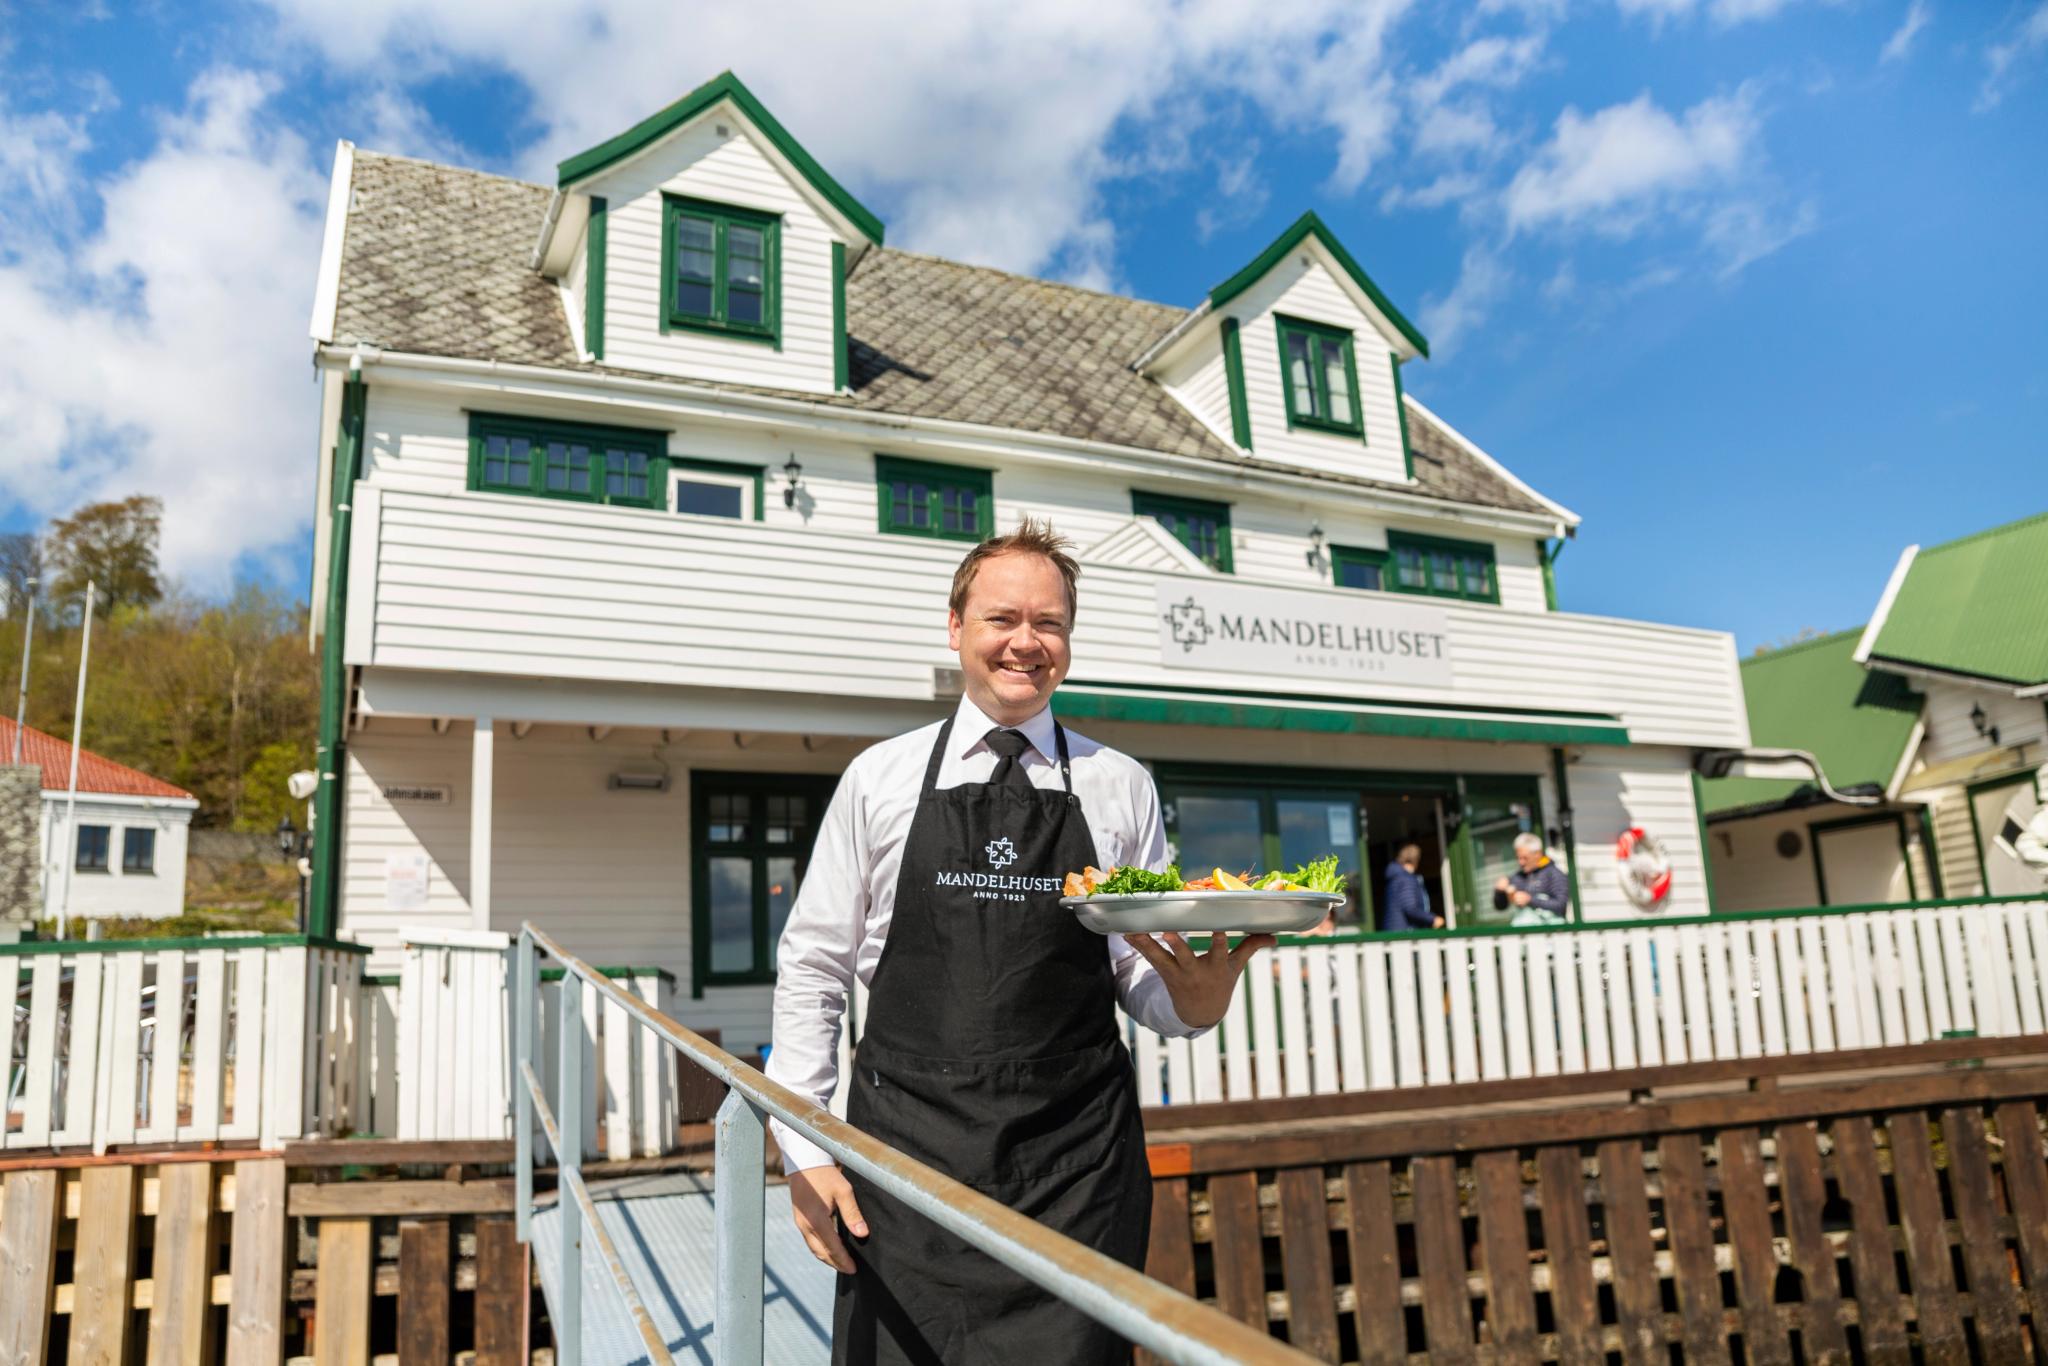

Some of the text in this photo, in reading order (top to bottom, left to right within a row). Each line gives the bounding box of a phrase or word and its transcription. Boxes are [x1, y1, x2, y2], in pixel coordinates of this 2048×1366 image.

[1219, 613, 1445, 659] MANDELHUSET
[1295, 653, 1339, 667] ANNO
[936, 872, 1062, 891] MANDELHUSET
[973, 891, 999, 900] ANNO
